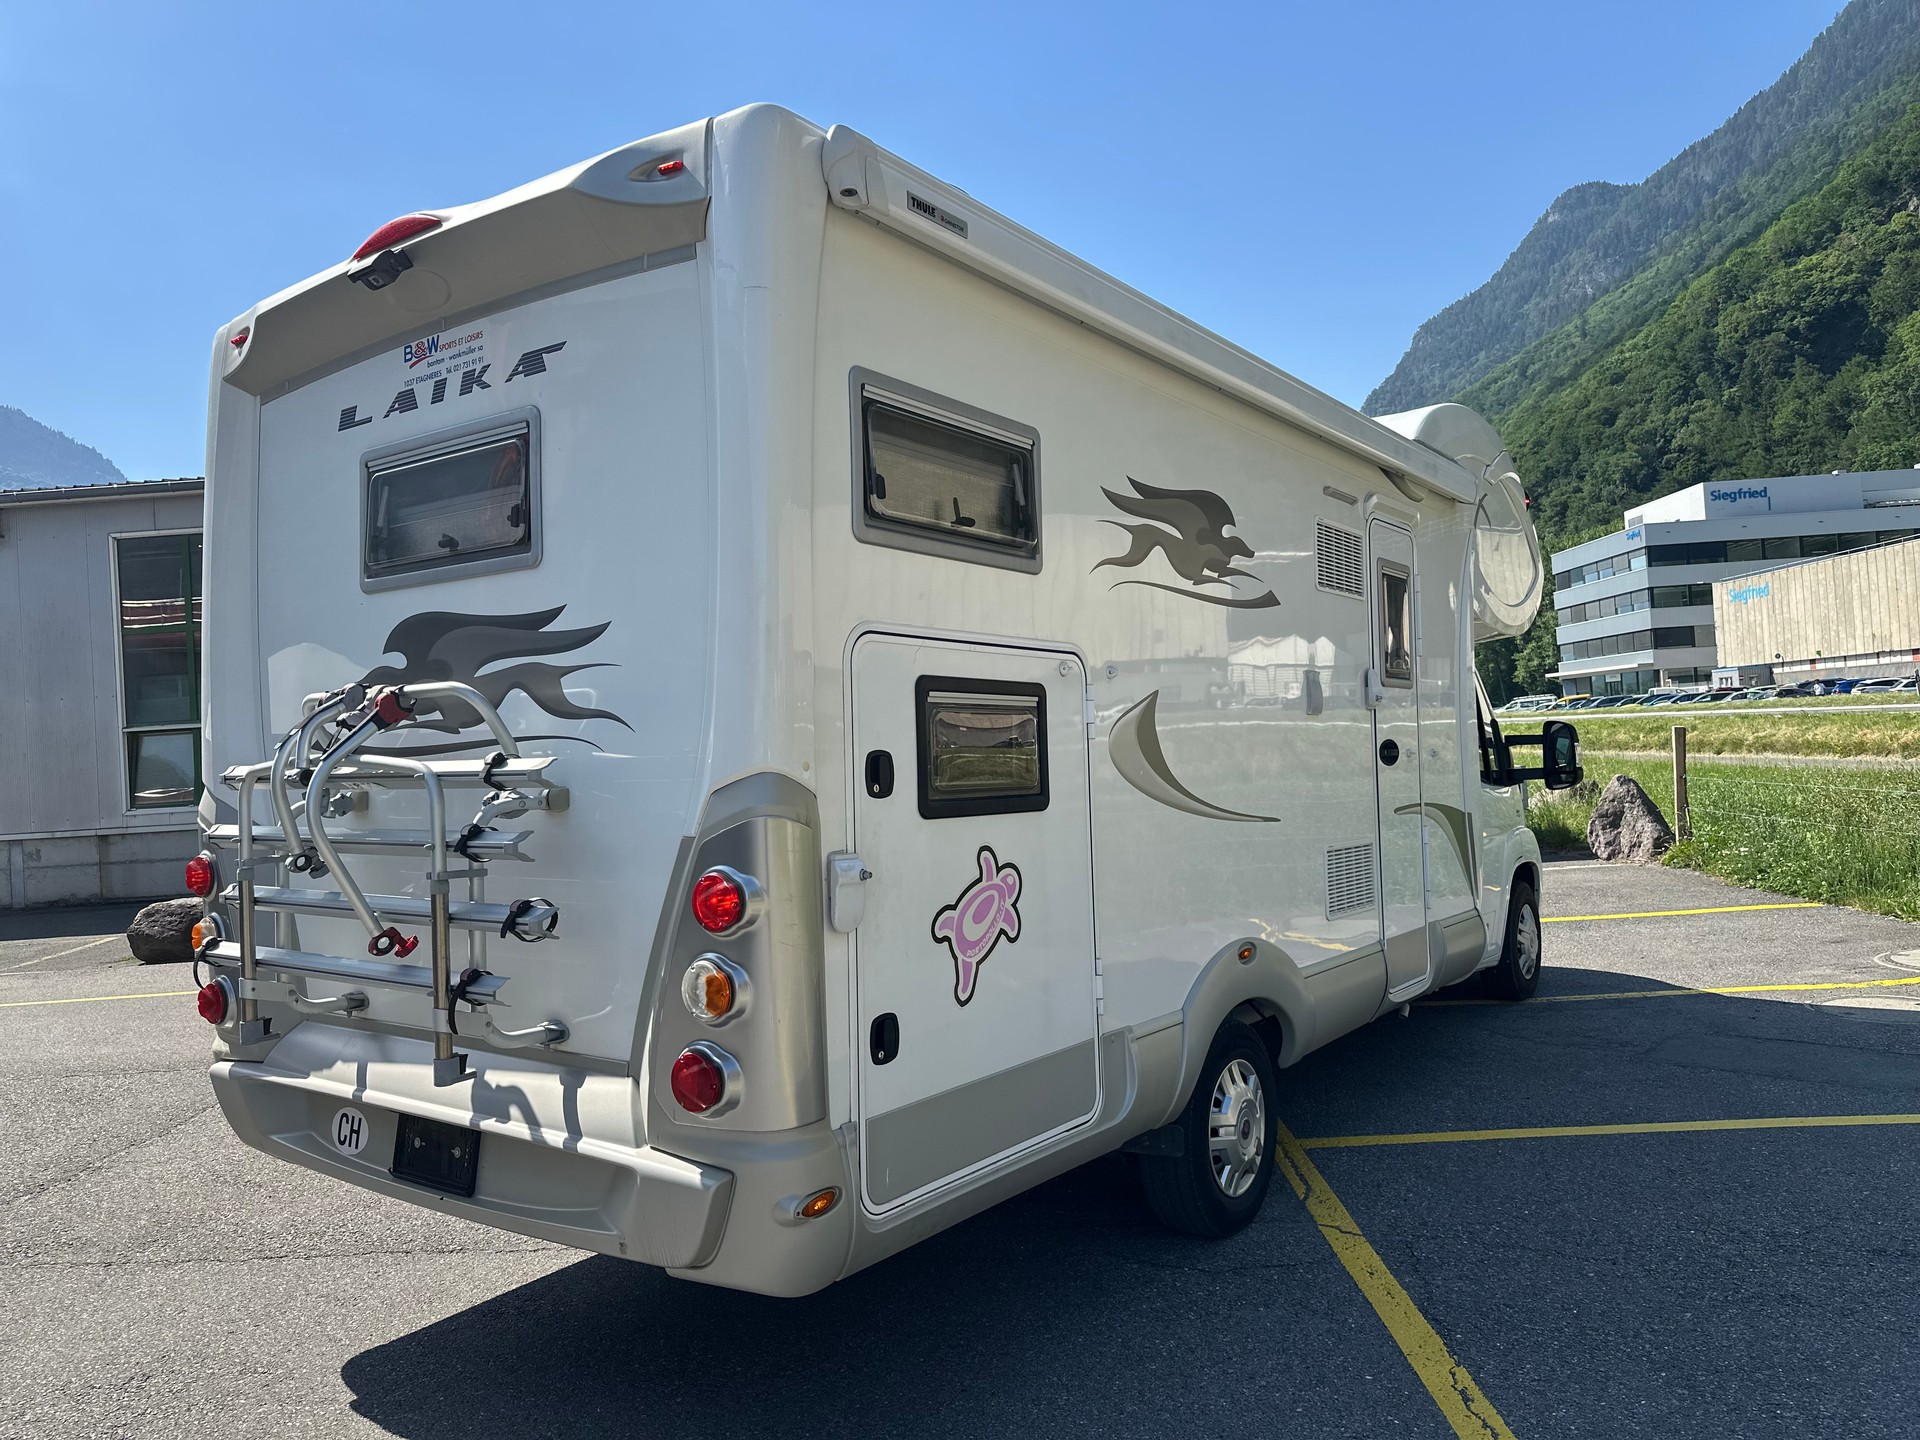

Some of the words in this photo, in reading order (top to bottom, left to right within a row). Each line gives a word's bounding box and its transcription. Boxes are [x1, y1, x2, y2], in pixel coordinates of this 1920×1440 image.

[911, 196, 936, 218] THULE
[404, 334, 440, 363] B&W
[439, 340, 457, 353] SPORTS
[458, 337, 464, 346] ET
[464, 330, 484, 344] LOISIRS
[337, 340, 568, 433] LAIKA
[404, 378, 415, 388] 1037
[453, 363, 462, 373] 021
[462, 360, 471, 369] 731
[471, 358, 478, 367] 91
[478, 356, 484, 365] 91
[1710, 487, 1768, 503] Siegfried
[1728, 582, 1770, 604] Siegfried
[337, 1112, 362, 1150] CH
